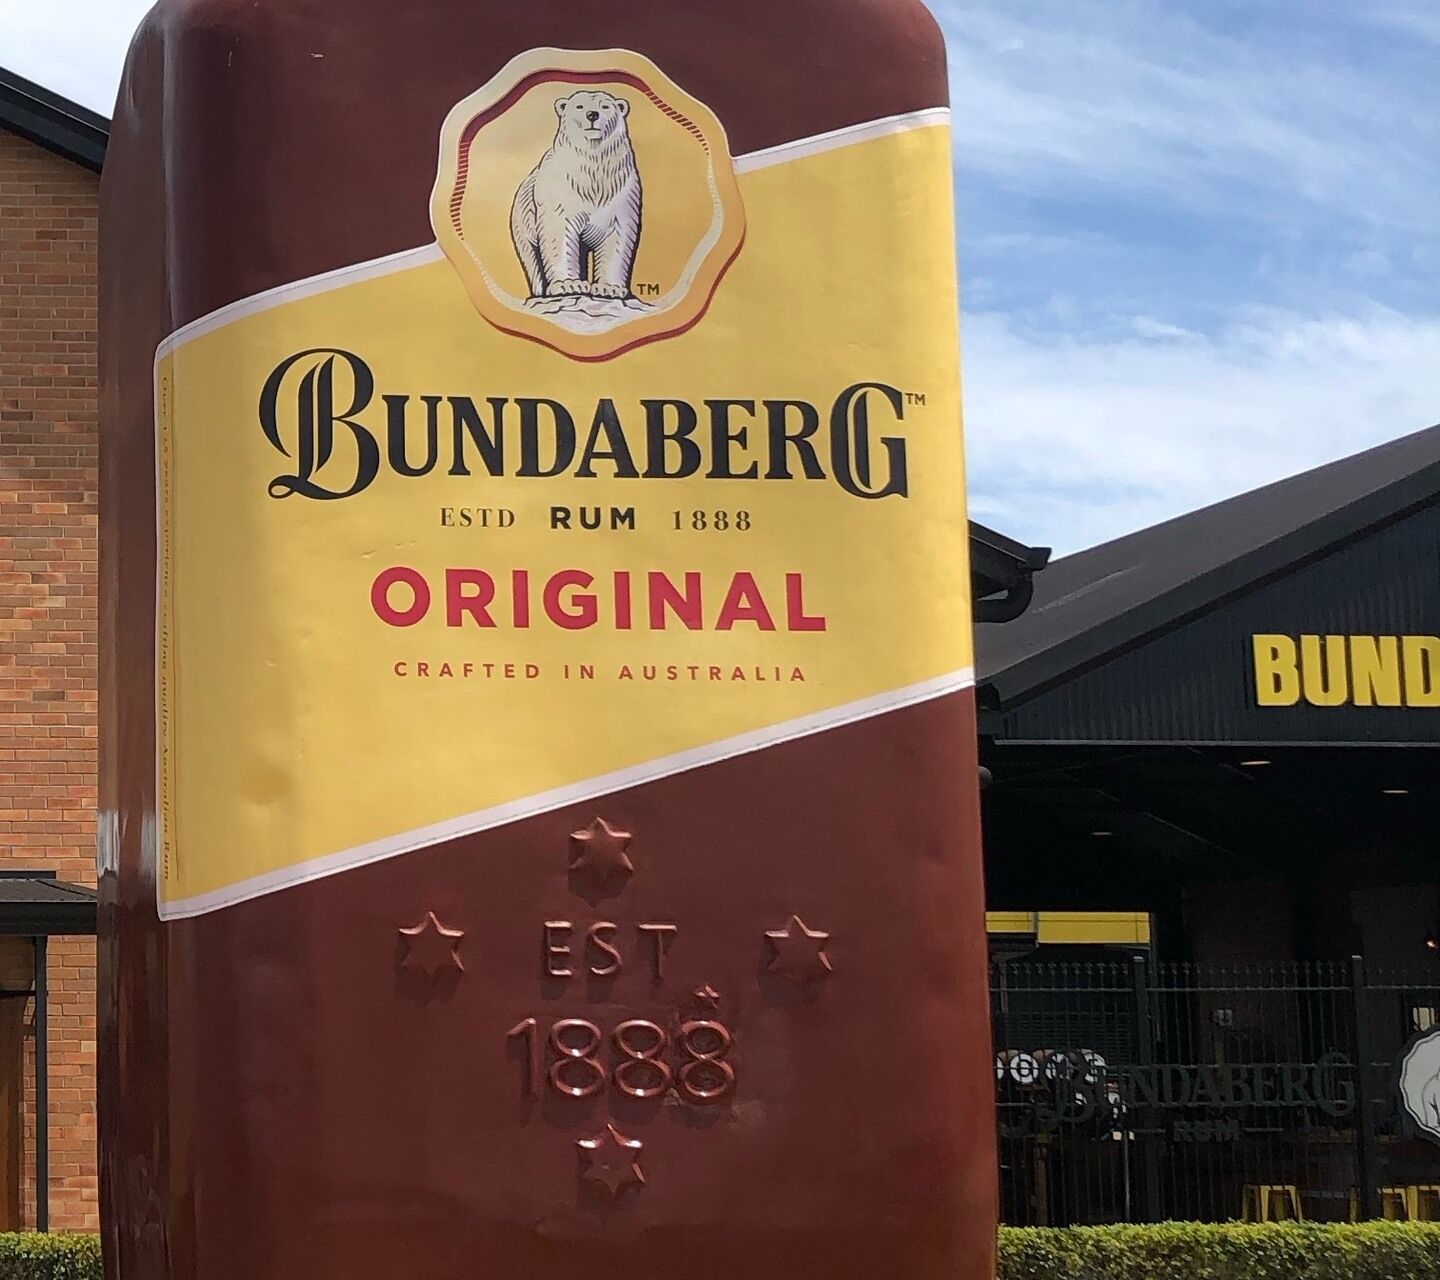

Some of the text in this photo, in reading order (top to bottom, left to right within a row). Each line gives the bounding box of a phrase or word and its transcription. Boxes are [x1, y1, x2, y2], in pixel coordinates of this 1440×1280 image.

[636, 283, 660, 296] TM
[259, 348, 909, 500] BUNDABERG
[440, 506, 753, 532] ESTD RUM 1888
[370, 566, 827, 631] ORIGINAL
[393, 661, 807, 682] CRAFTED IN AUSTRALIA
[1252, 633, 1440, 707] BUND
[544, 921, 678, 978] EST
[506, 1018, 736, 1100] 1888
